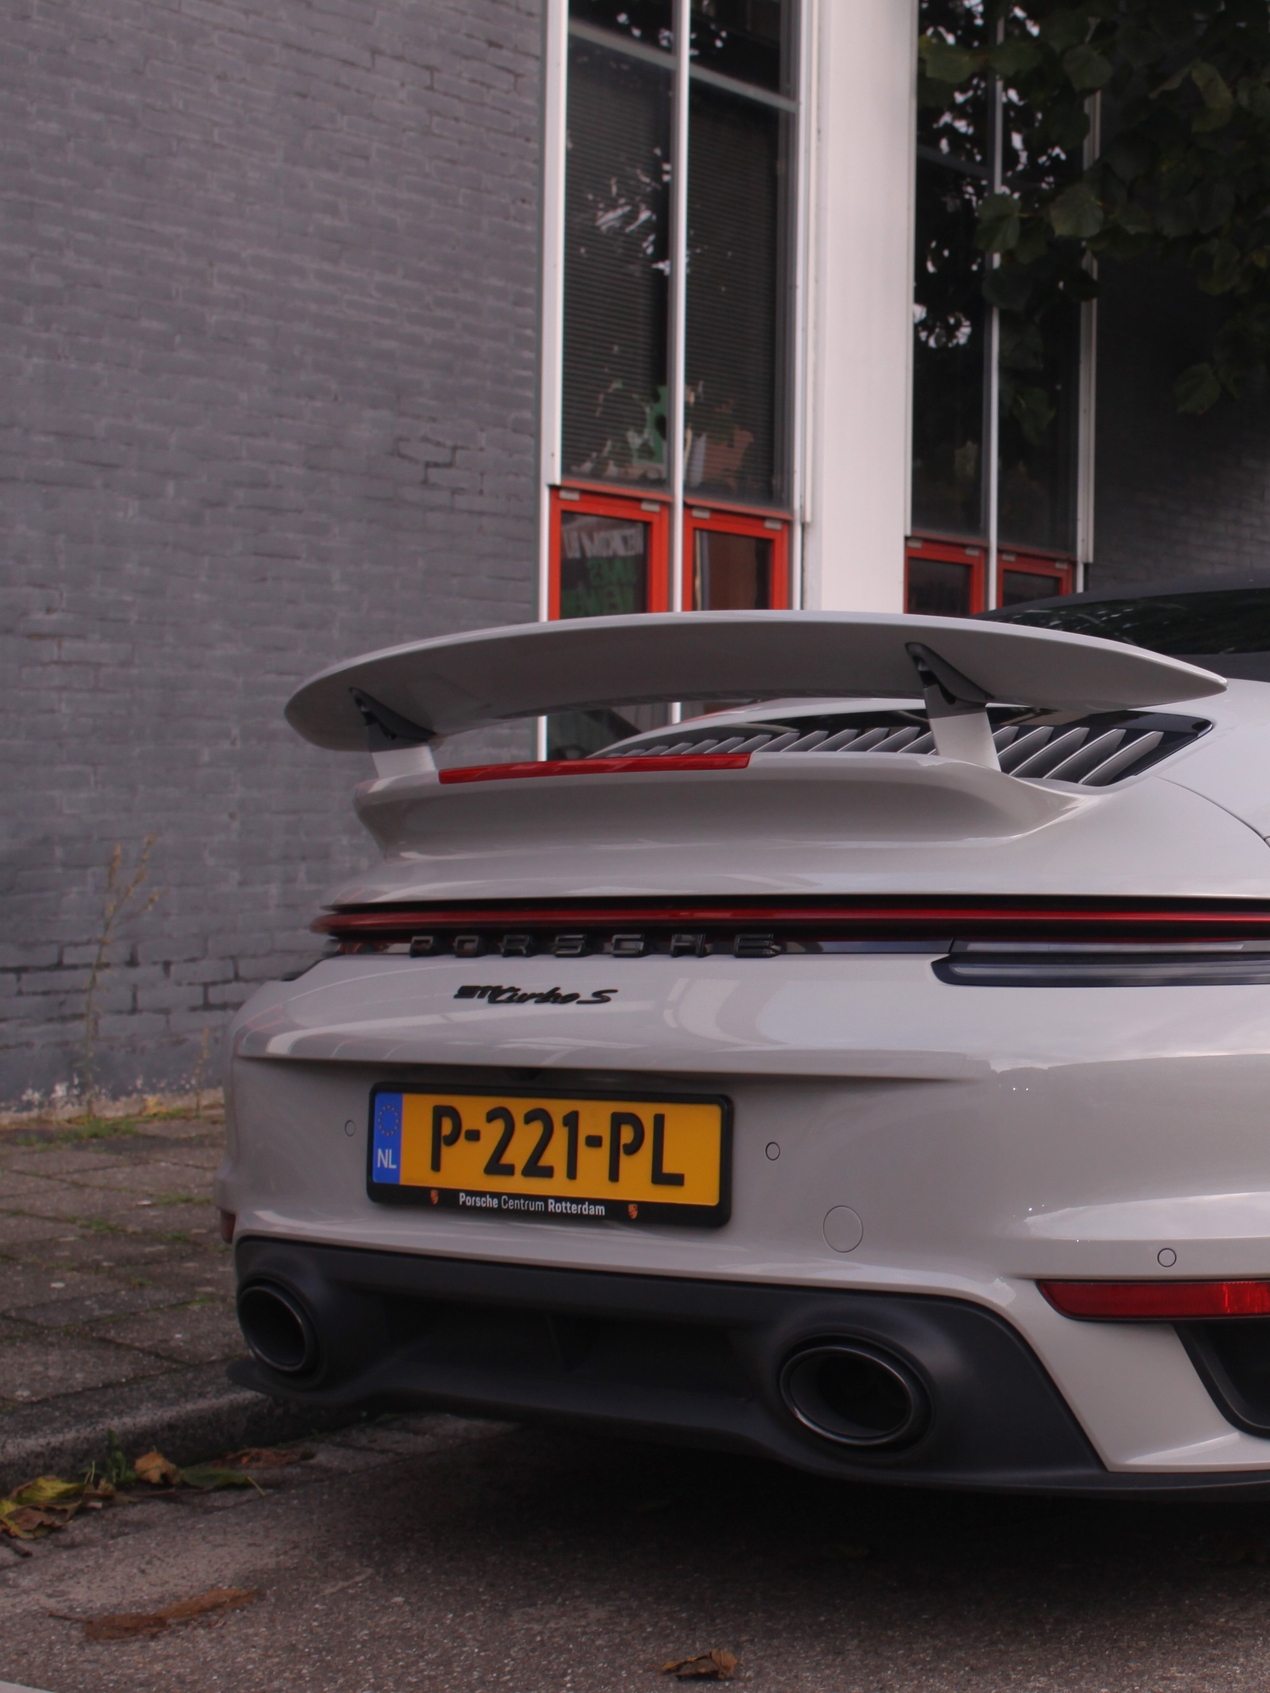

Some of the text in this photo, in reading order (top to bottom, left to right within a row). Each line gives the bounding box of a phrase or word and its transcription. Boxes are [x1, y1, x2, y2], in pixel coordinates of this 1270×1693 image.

[409, 933, 781, 958] PORSCHE
[488, 986, 580, 1004] Turbo
[576, 989, 618, 1004] S
[430, 1105, 685, 1187] P-221-PL
[377, 1148, 397, 1169] NL
[459, 1192, 605, 1216] Porsche Centrum Rotterdam
